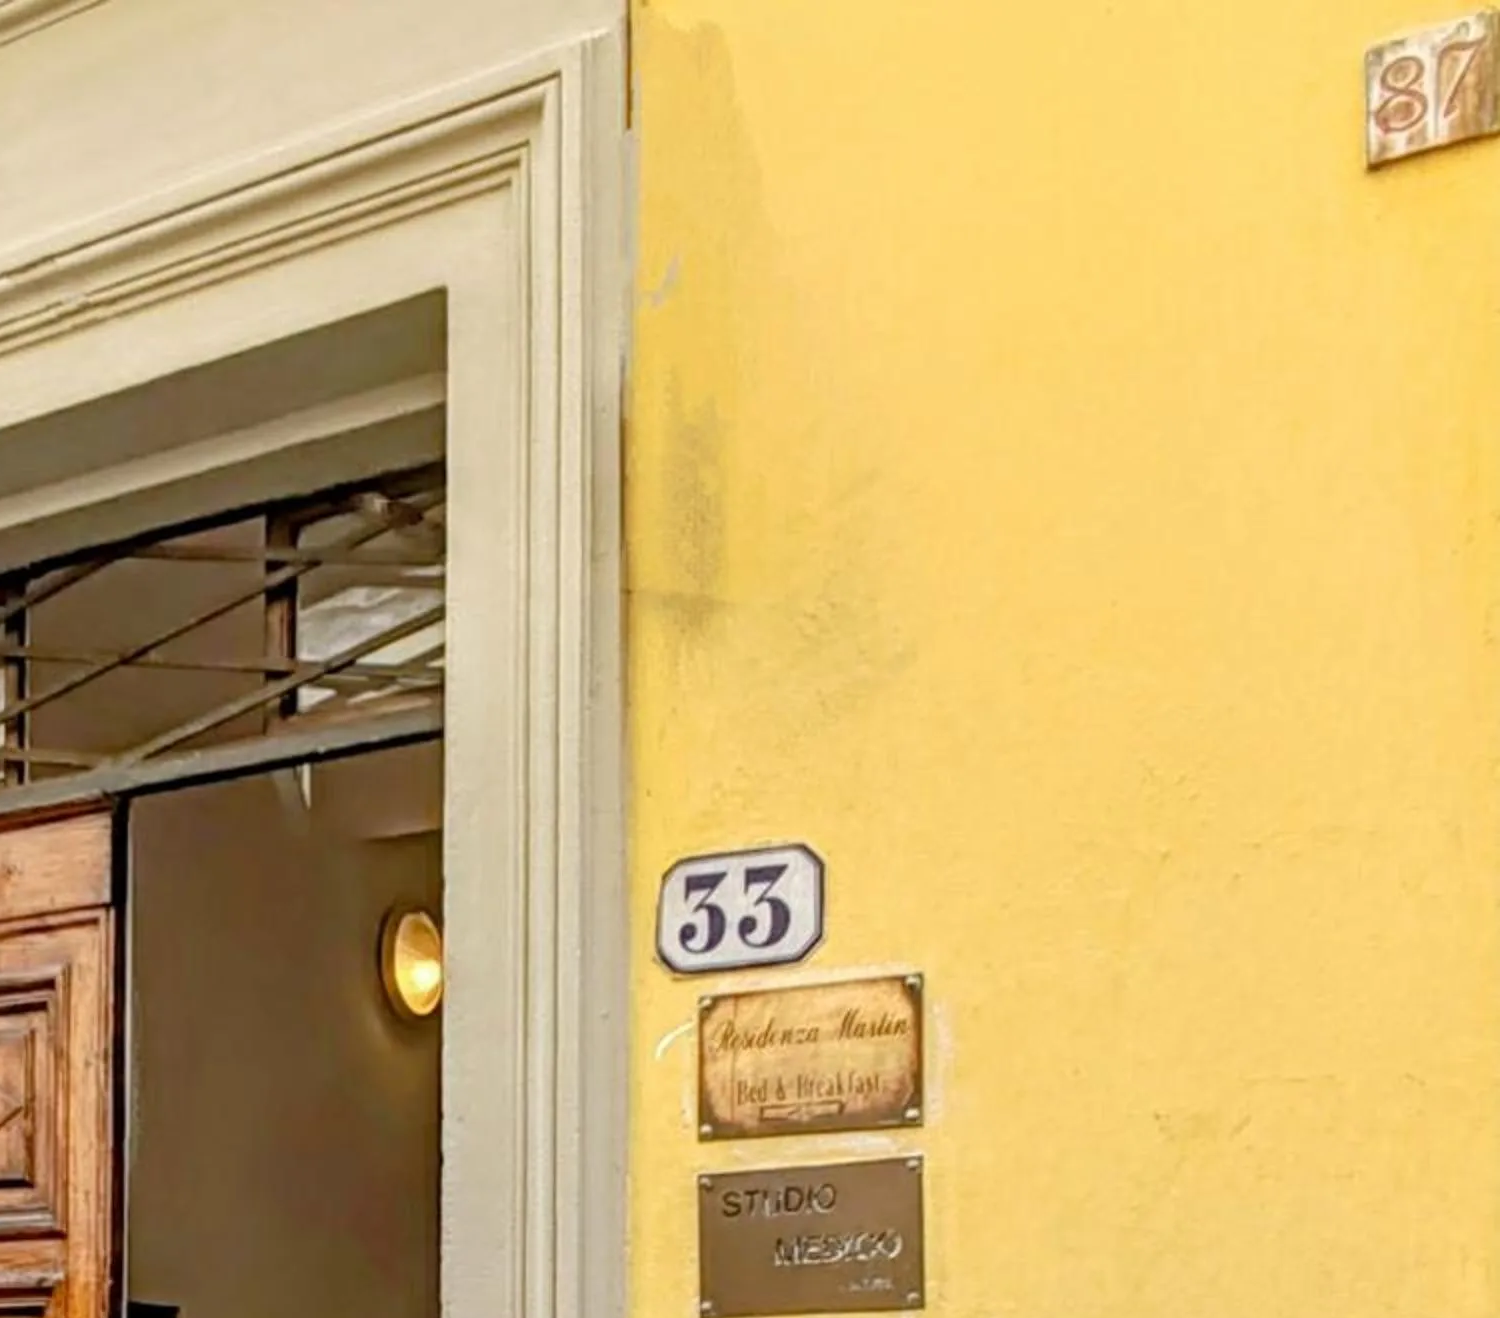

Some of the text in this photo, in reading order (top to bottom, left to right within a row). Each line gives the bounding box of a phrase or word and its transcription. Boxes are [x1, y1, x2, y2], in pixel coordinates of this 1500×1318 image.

[1373, 34, 1489, 135] 87
[679, 863, 791, 955] 33
[712, 1017, 820, 1051] Residenza
[737, 1077, 768, 1105] Bed
[797, 1071, 881, 1100] Breakfast
[721, 1183, 837, 1218] STUDIO
[773, 1228, 904, 1267] MEDICO
